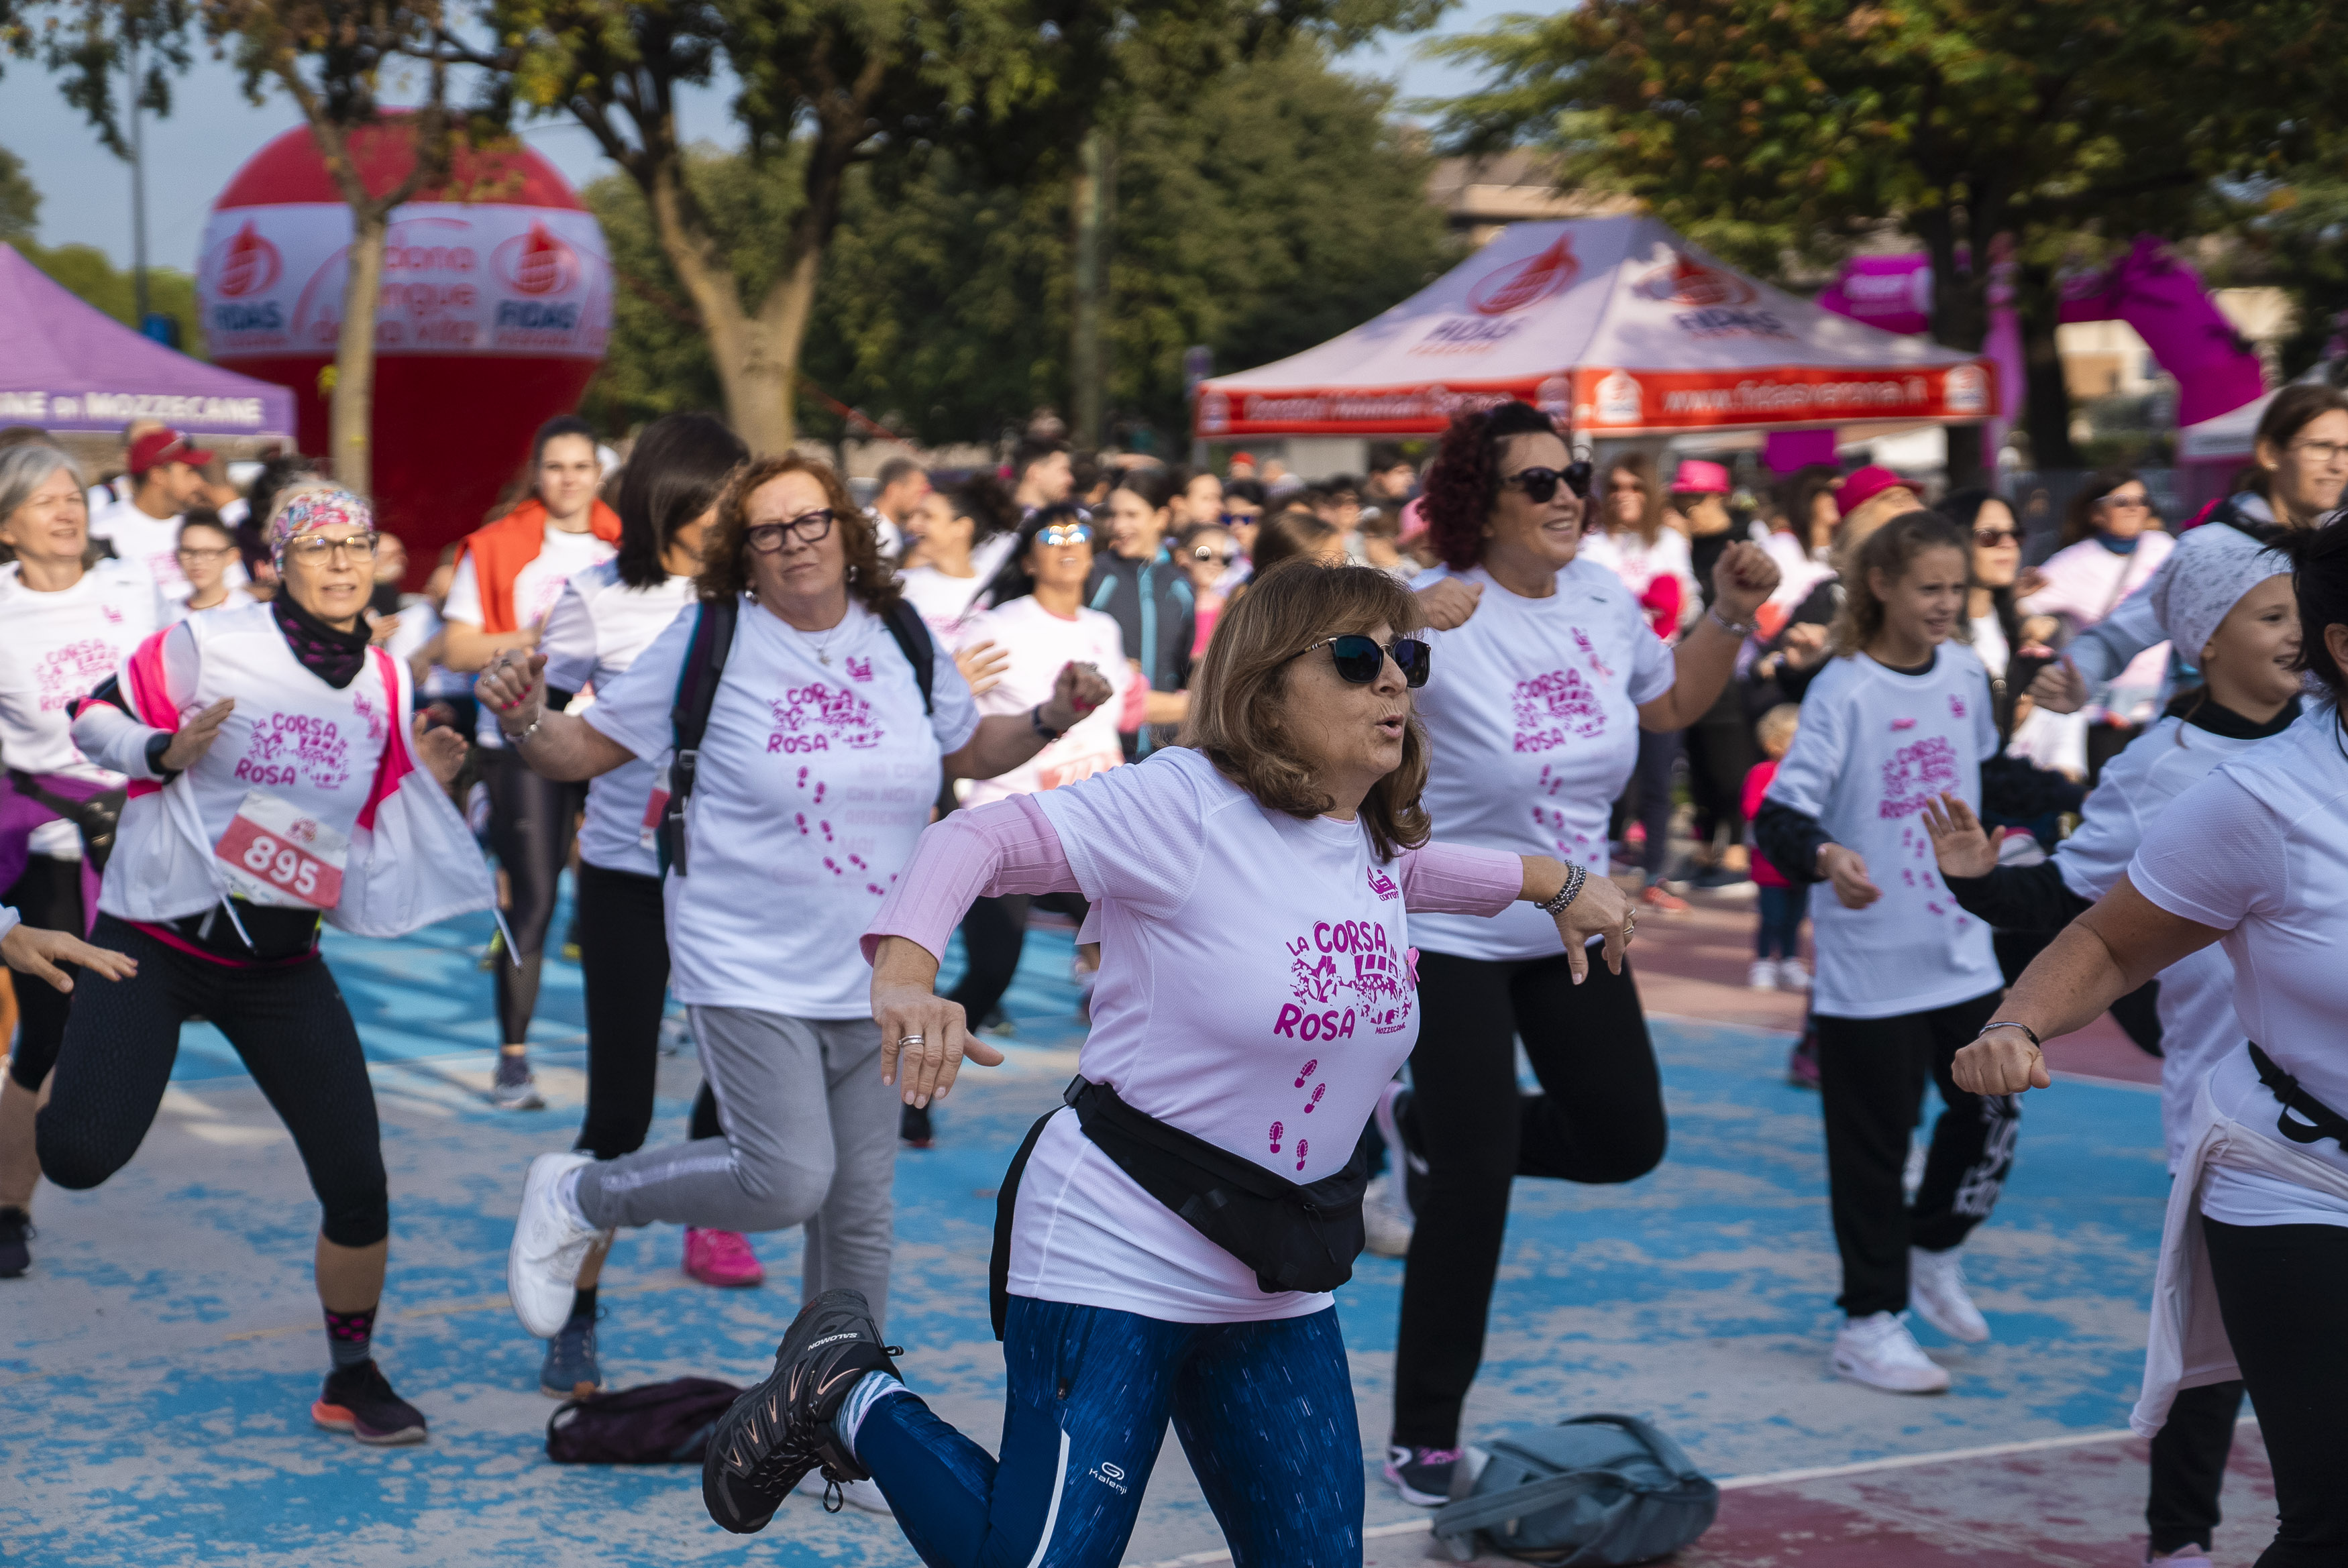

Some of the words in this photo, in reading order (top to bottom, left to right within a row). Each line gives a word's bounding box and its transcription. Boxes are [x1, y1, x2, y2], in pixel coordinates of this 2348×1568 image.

[272, 712, 337, 740] CORSA
[766, 732, 829, 753] ROSA
[235, 757, 297, 785] ROSA
[244, 836, 319, 895] 895
[1286, 936, 1310, 956] LA
[1314, 920, 1387, 954] CORSA
[1273, 1003, 1355, 1041] ROSA
[1375, 1021, 1406, 1034] MOZZECANE
[807, 1333, 858, 1351] SALOMON
[1089, 1468, 1128, 1495] Kalenji
